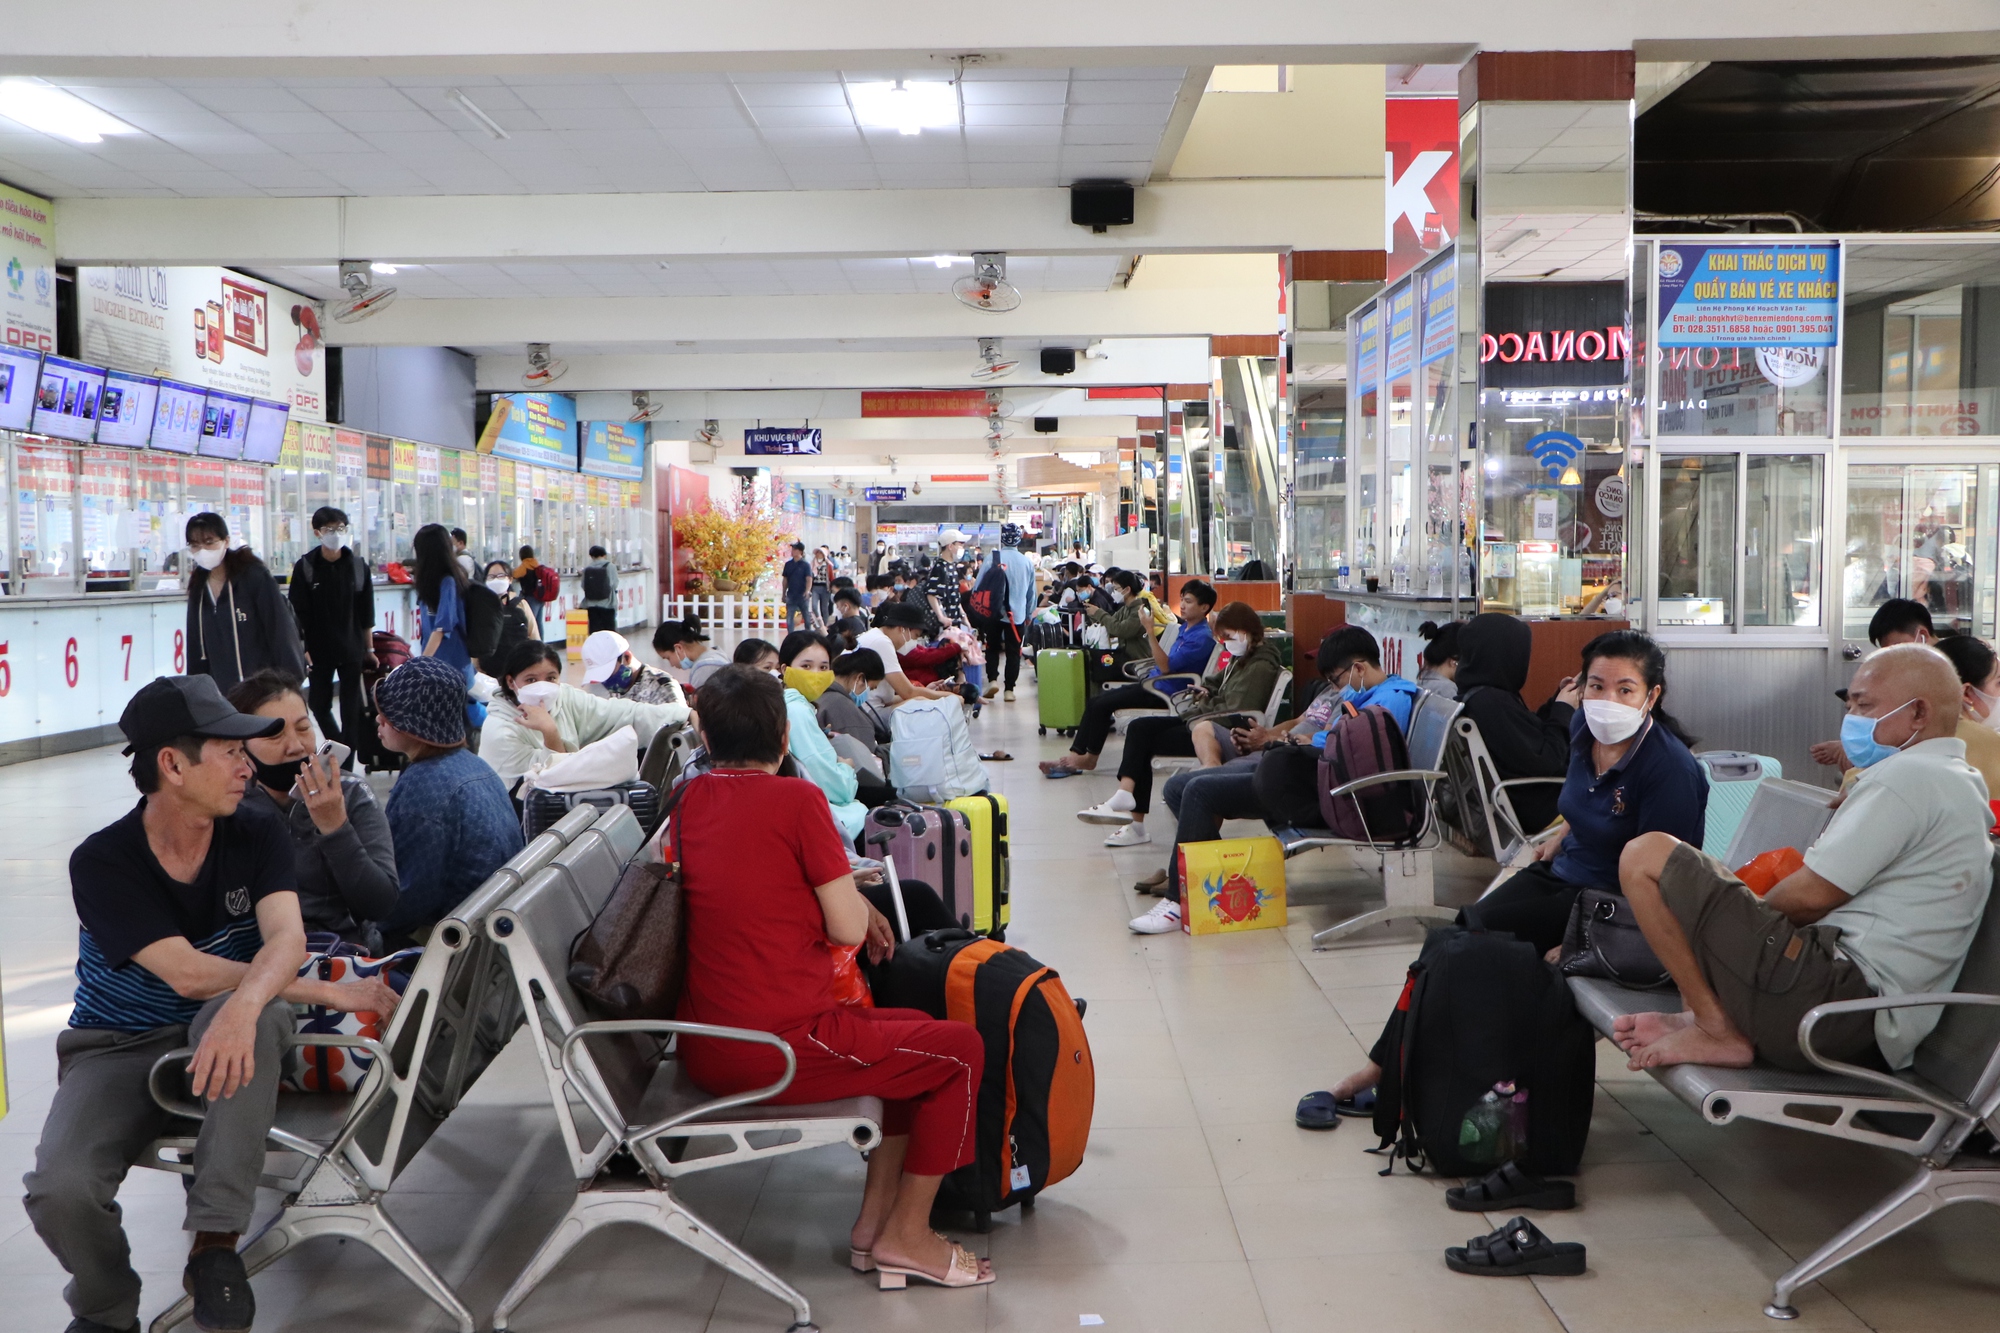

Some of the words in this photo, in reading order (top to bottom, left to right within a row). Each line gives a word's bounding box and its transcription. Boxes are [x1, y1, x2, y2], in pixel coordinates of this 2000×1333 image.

[1708, 254, 1739, 271] KHAI
[1741, 250, 1774, 271] THÁC
[1777, 254, 1806, 274] DỊCH
[1809, 254, 1827, 274] VỤ
[1730, 278, 1756, 299] BÁN
[1759, 278, 1775, 299] VÉ
[1778, 281, 1794, 299] XE
[1797, 278, 1837, 299] KHÁCH
[93, 296, 127, 321] LINGZHI
[129, 307, 165, 331] EXTRACT
[1723, 305, 1744, 313] Phòng
[1757, 305, 1779, 313] Hoạch
[1673, 314, 1697, 322] Email:
[1698, 314, 1833, 324] phongkhvt@benxemiendong.com.vn
[1673, 325, 1686, 333] ĐT:
[1687, 325, 1750, 333] 028.3511.6858
[1752, 324, 1774, 335] hoặc
[1776, 325, 1833, 333] 0901.395.041
[6, 327, 52, 352] OPC
[296, 393, 319, 410] OPC
[1720, 403, 1734, 418] TUM
[754, 434, 769, 442] KHU
[770, 432, 785, 444] VỰC
[787, 432, 801, 442] BÁN
[384, 610, 395, 635] 14
[411, 608, 422, 640] 15
[0, 640, 11, 697] 5
[65, 637, 79, 688] 6
[121, 635, 133, 681] 7
[173, 629, 185, 674] 8
